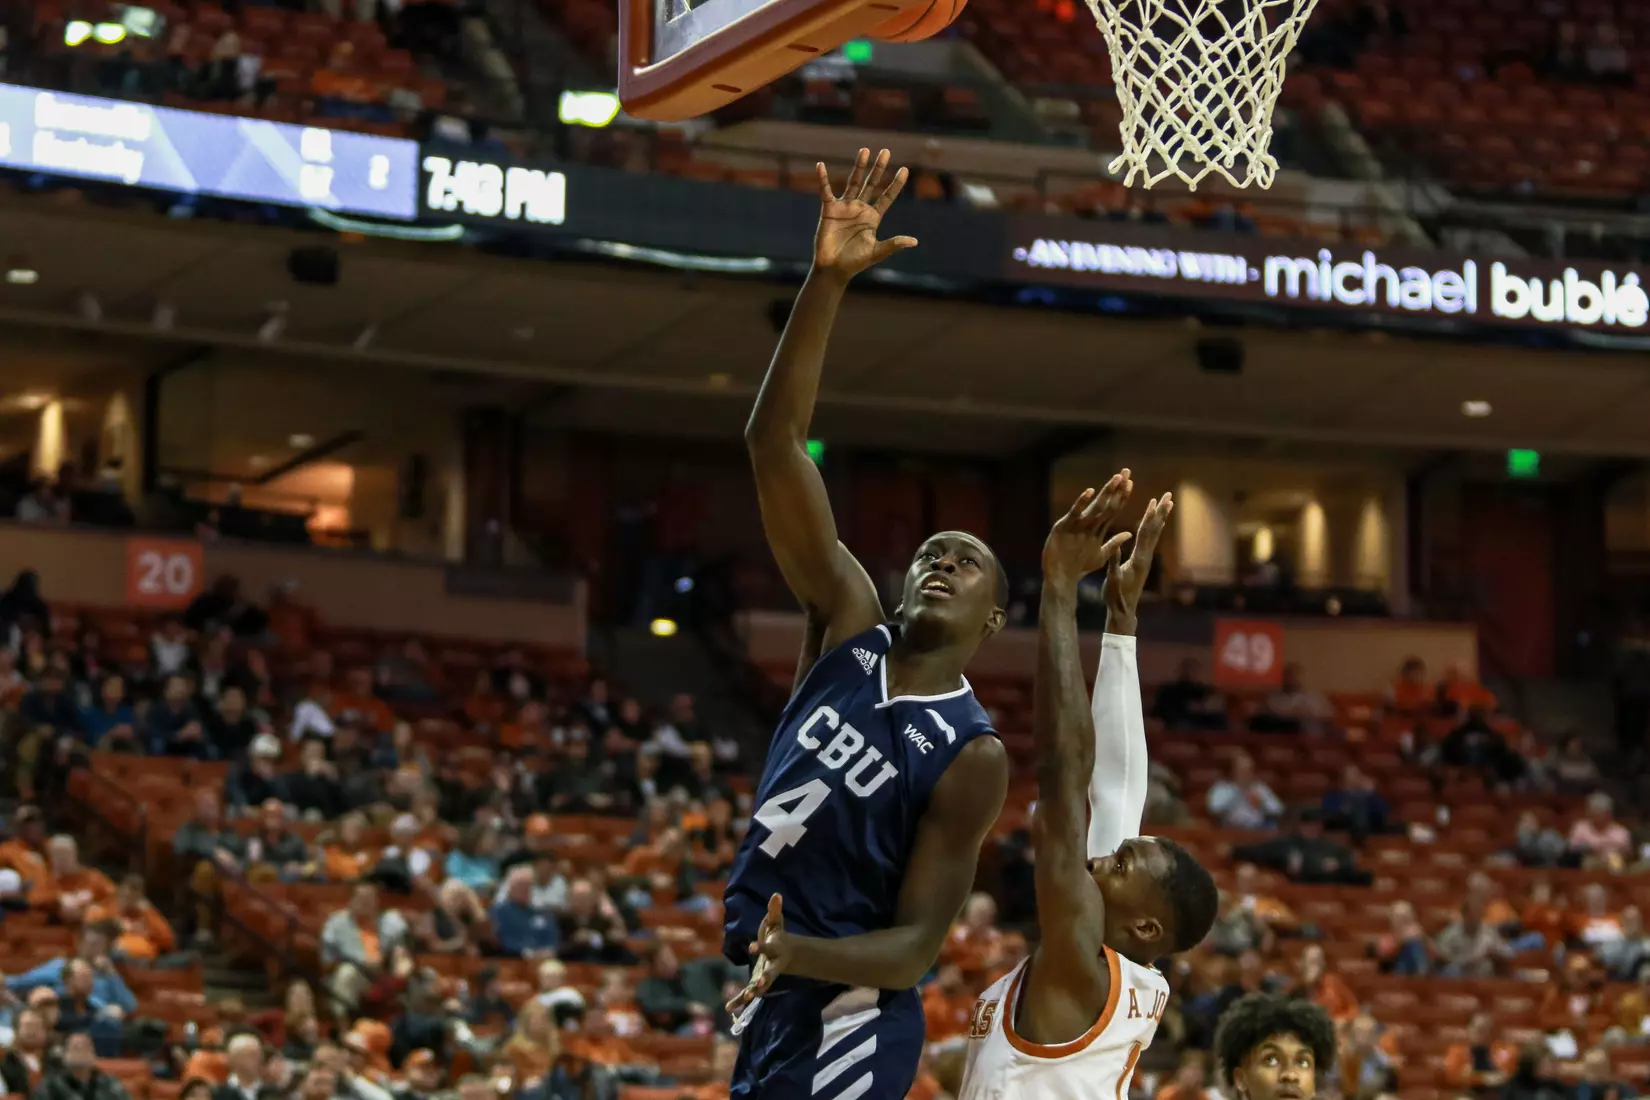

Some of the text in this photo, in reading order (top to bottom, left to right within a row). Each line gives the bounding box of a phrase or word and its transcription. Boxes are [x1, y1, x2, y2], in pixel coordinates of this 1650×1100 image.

[505, 167, 566, 225] PM
[1264, 248, 1649, 328] michael bublé
[138, 550, 193, 594] 20
[852, 647, 873, 676] adidas
[1222, 632, 1275, 675] 49
[797, 705, 899, 798] CBU
[904, 723, 934, 755] WAC
[753, 778, 832, 859] 4
